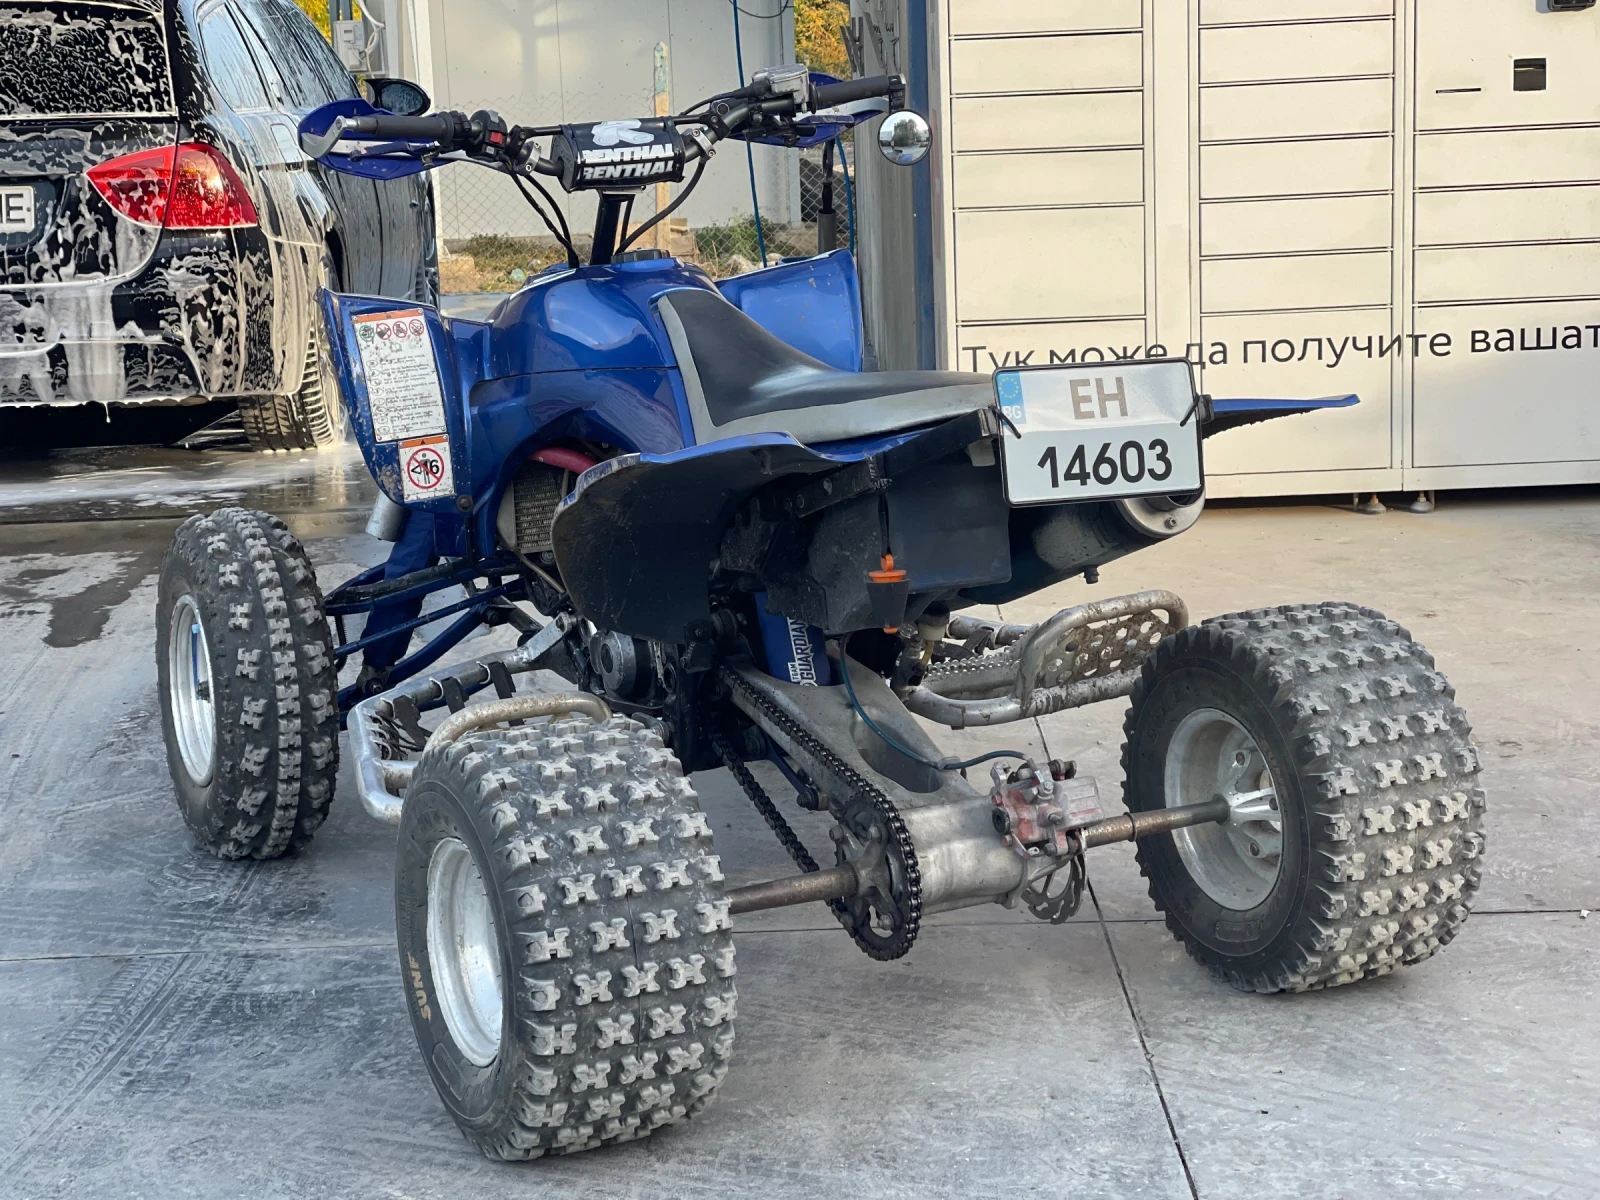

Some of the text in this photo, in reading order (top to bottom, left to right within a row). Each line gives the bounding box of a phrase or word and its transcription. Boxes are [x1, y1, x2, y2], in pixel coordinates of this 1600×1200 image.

[0, 193, 25, 223] E
[1185, 341, 1228, 370] да
[1242, 331, 1451, 368] получите
[1001, 405, 1022, 419] BG
[1069, 376, 1129, 420] EH
[1037, 438, 1173, 489] 14603
